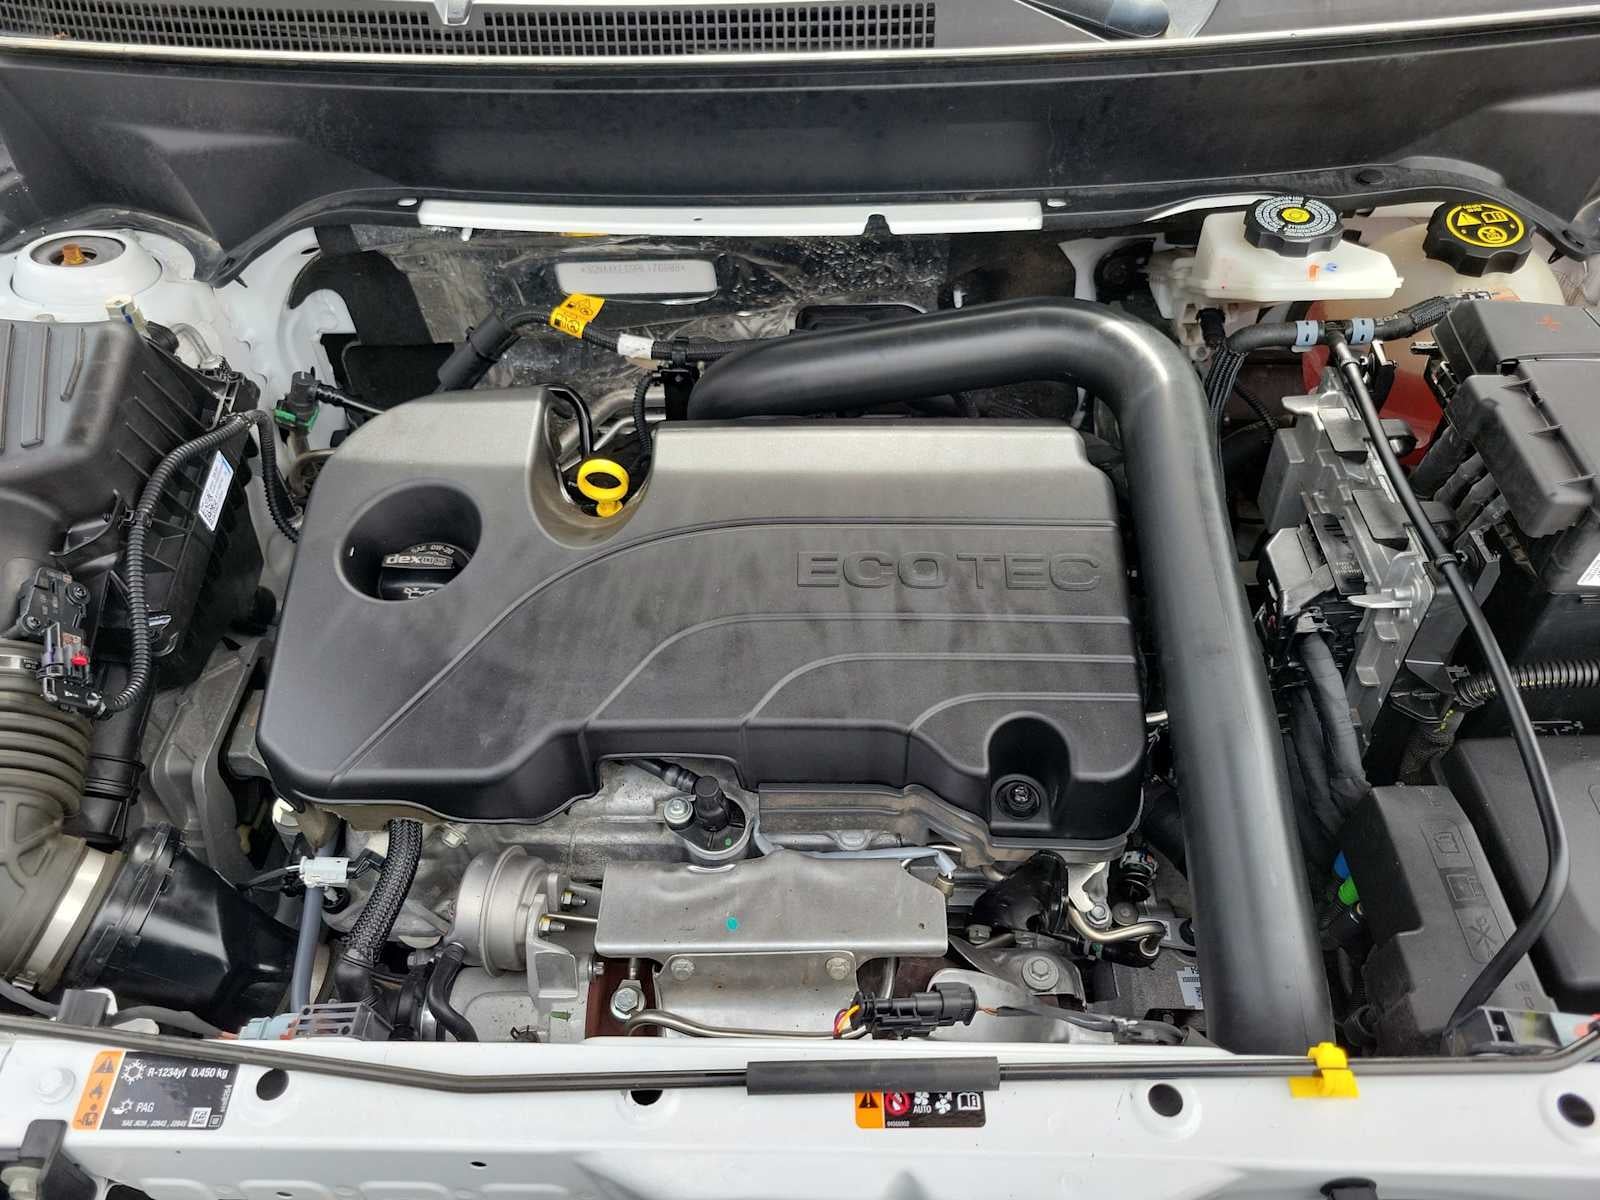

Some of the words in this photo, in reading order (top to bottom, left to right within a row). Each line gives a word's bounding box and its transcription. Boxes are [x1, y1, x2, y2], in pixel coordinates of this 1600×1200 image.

[796, 551, 1101, 592] ECOTEC
[147, 1067, 187, 1079] R-1234yf
[191, 1067, 216, 1078] 0.450
[216, 1068, 229, 1079] kg
[136, 1102, 155, 1113] PAG
[913, 1105, 932, 1114] AUTO
